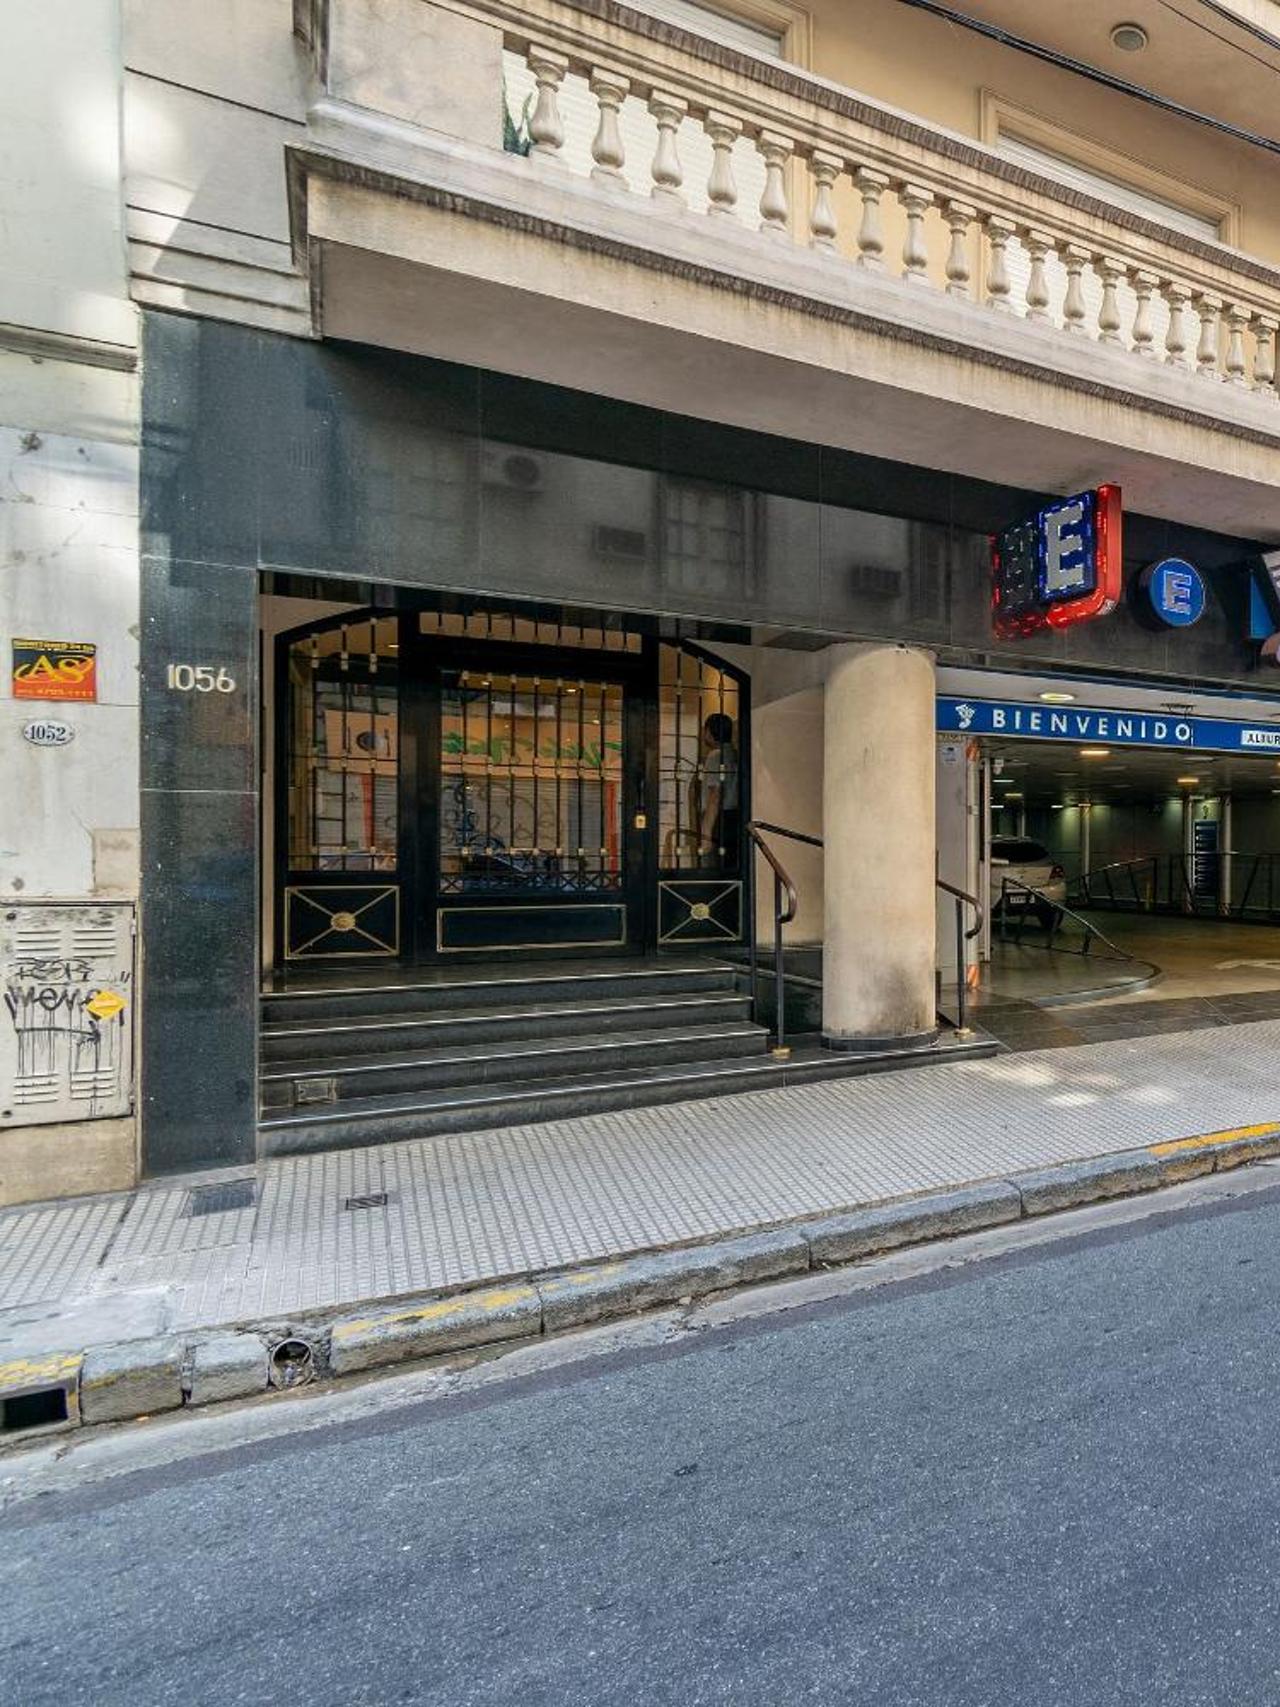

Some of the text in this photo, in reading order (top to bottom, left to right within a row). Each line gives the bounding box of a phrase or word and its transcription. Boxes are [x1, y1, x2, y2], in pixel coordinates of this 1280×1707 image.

[1044, 501, 1084, 593] E
[1163, 570, 1192, 614] E
[167, 664, 236, 692] 1056
[31, 725, 65, 741] 1052
[992, 709, 1190, 740] BIENVENIDO
